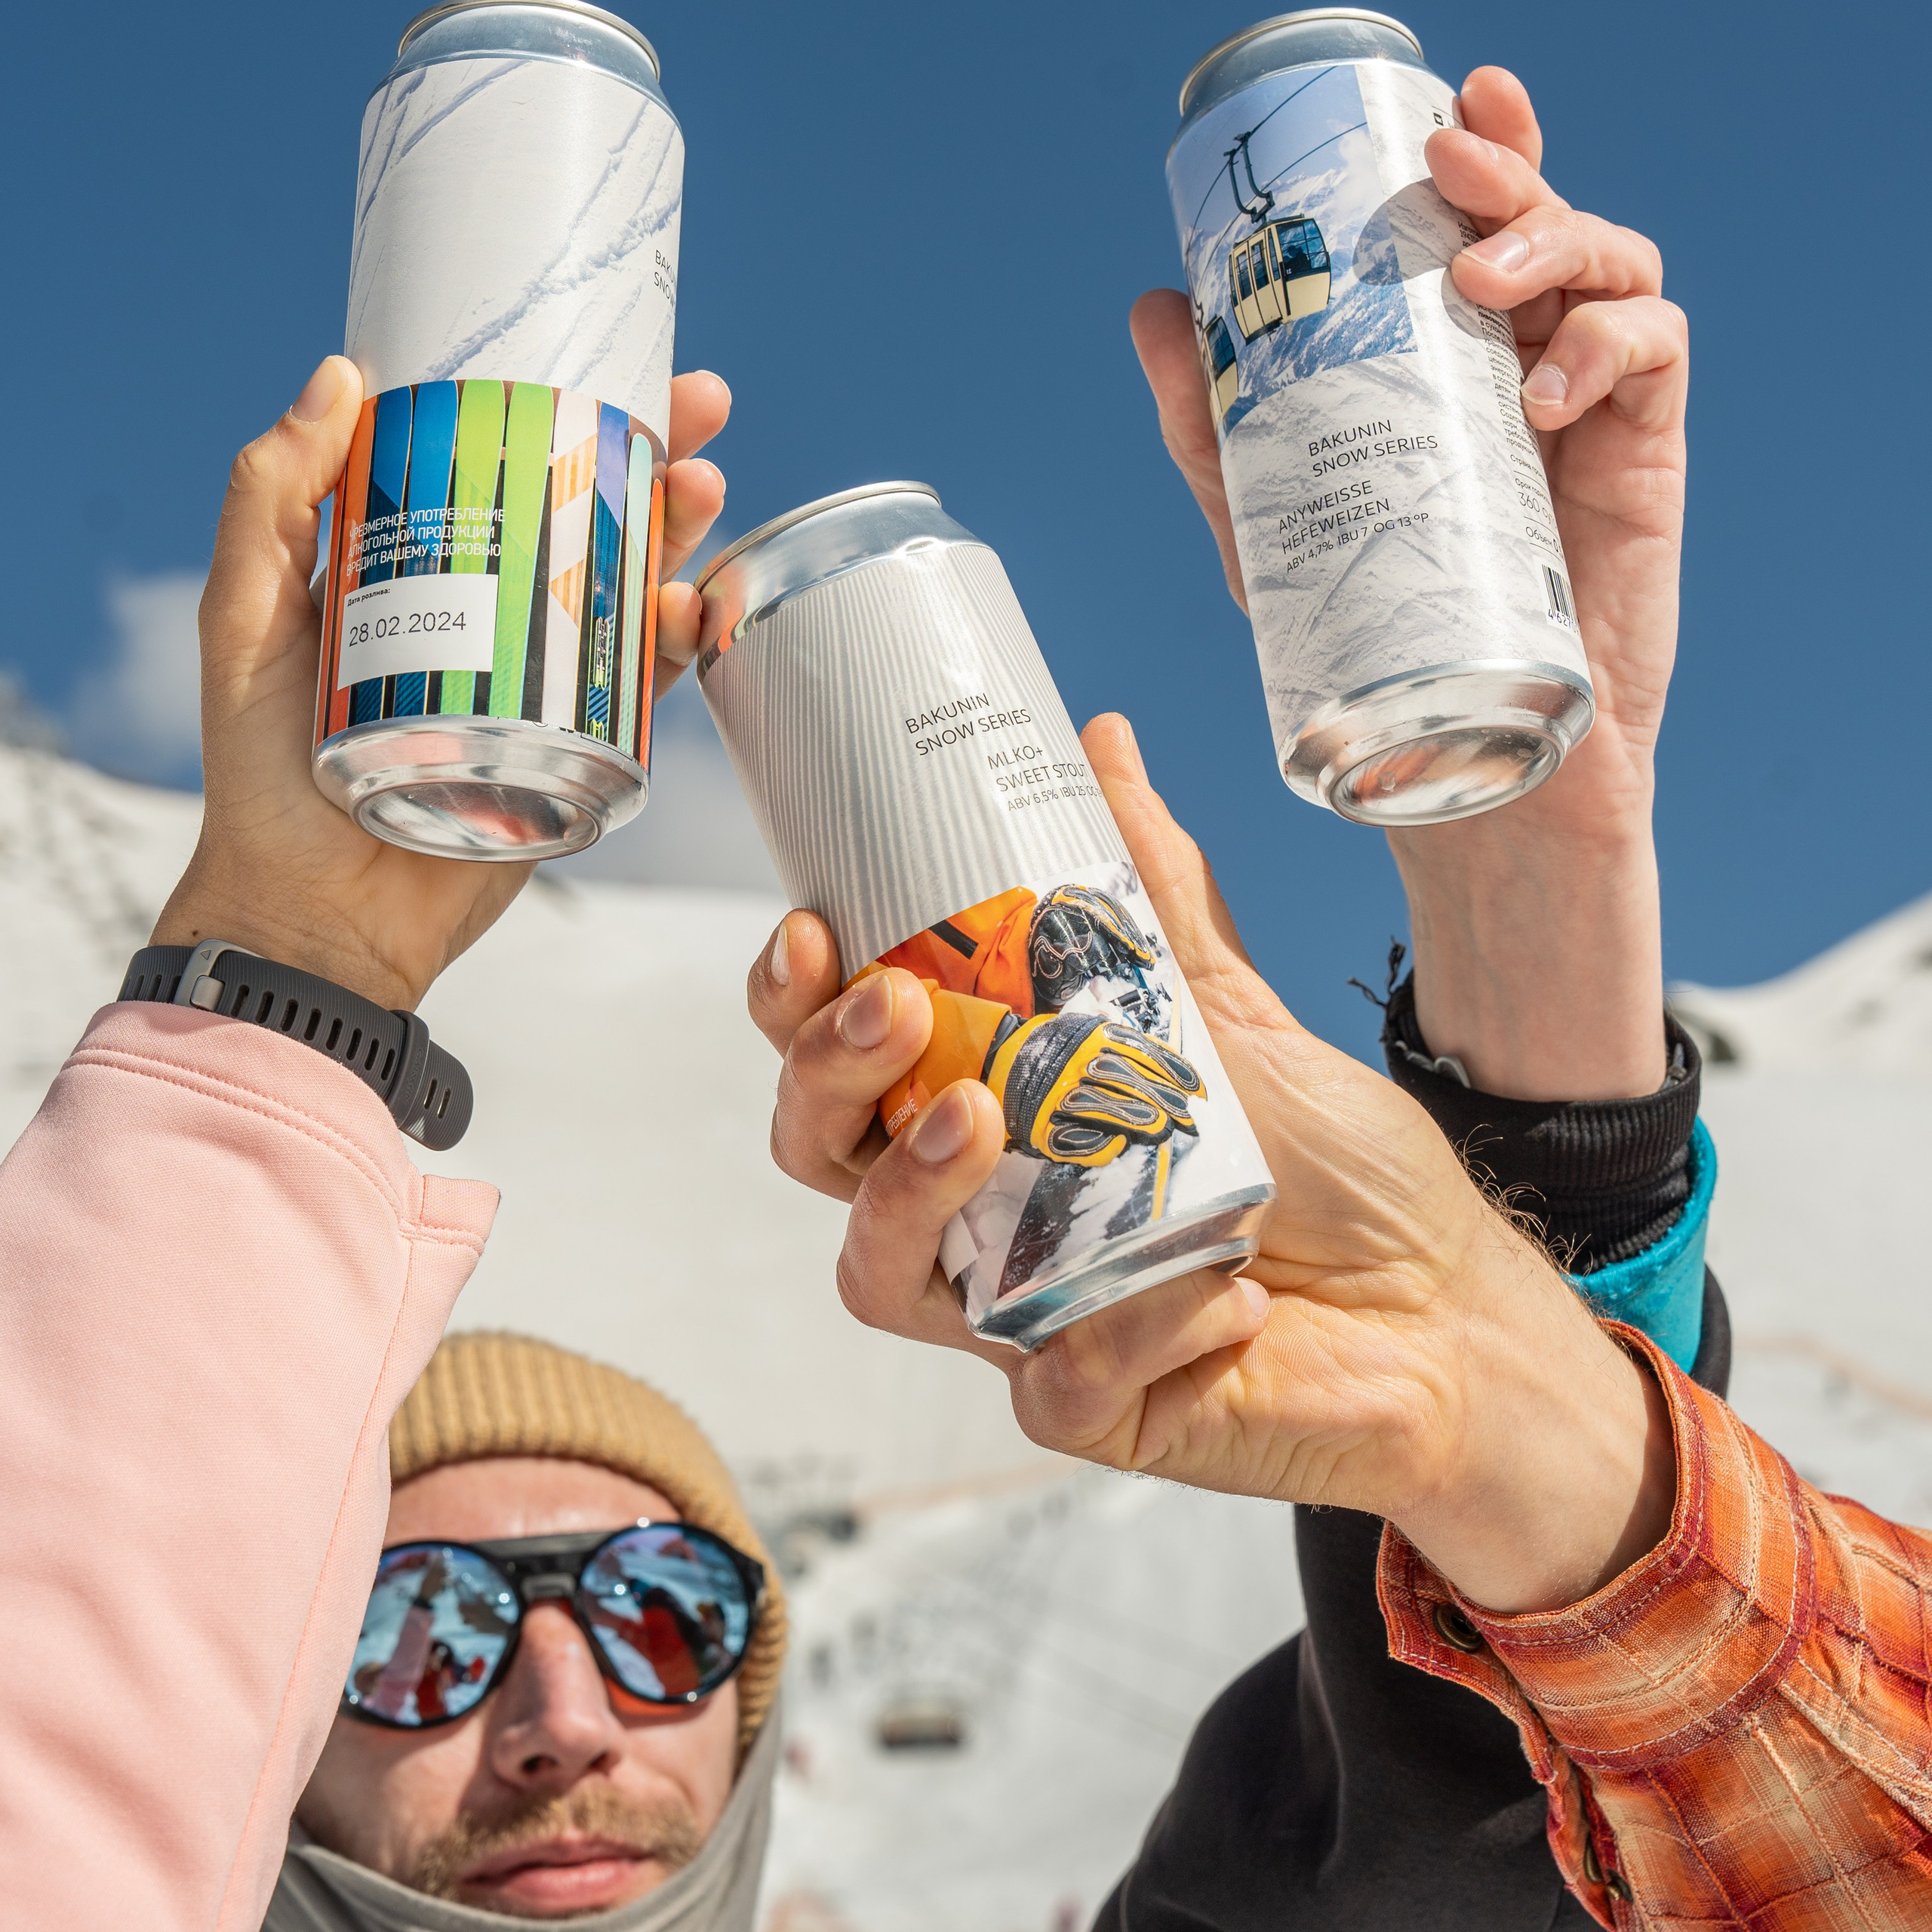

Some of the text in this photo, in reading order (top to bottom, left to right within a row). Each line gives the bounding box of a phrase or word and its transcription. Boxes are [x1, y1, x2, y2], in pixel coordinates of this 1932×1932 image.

[1309, 420, 1392, 457] BAKUNIN
[1312, 435, 1438, 477] SNOW SERIES
[1278, 480, 1373, 534] ANYWEISSE
[1518, 491, 1540, 512] 360
[349, 507, 506, 540] ЧРЕЗМЕРНОЕ УПОТРЕБЛЕНИЕ
[1281, 498, 1390, 555] HEFEWEIZEN
[346, 543, 502, 577] ВРЕДИТ ВАШЕМУ ЗДОРОВЬЮ
[347, 525, 495, 560] АЛКОГОЛЬНОЙ ПРОДУКЦИИ
[1286, 552, 1306, 574] ABV
[1308, 540, 1334, 560] 4,7%
[1337, 530, 1359, 546] IBU
[1360, 526, 1368, 537] 7
[1374, 519, 1395, 533] OG
[1397, 516, 1412, 528] 13
[347, 589, 391, 608] Дата розлива:
[349, 611, 466, 648] 28.02.2024
[905, 693, 990, 735] BAKUNIN
[915, 709, 1032, 756] SNOW SERIES
[987, 746, 1044, 770] MLKO+
[995, 764, 1089, 792] SWEET STOUT
[1008, 795, 1031, 811] ABV
[1032, 789, 1059, 804] 6,5%
[1060, 786, 1076, 798] IBU
[1075, 786, 1086, 796] 25
